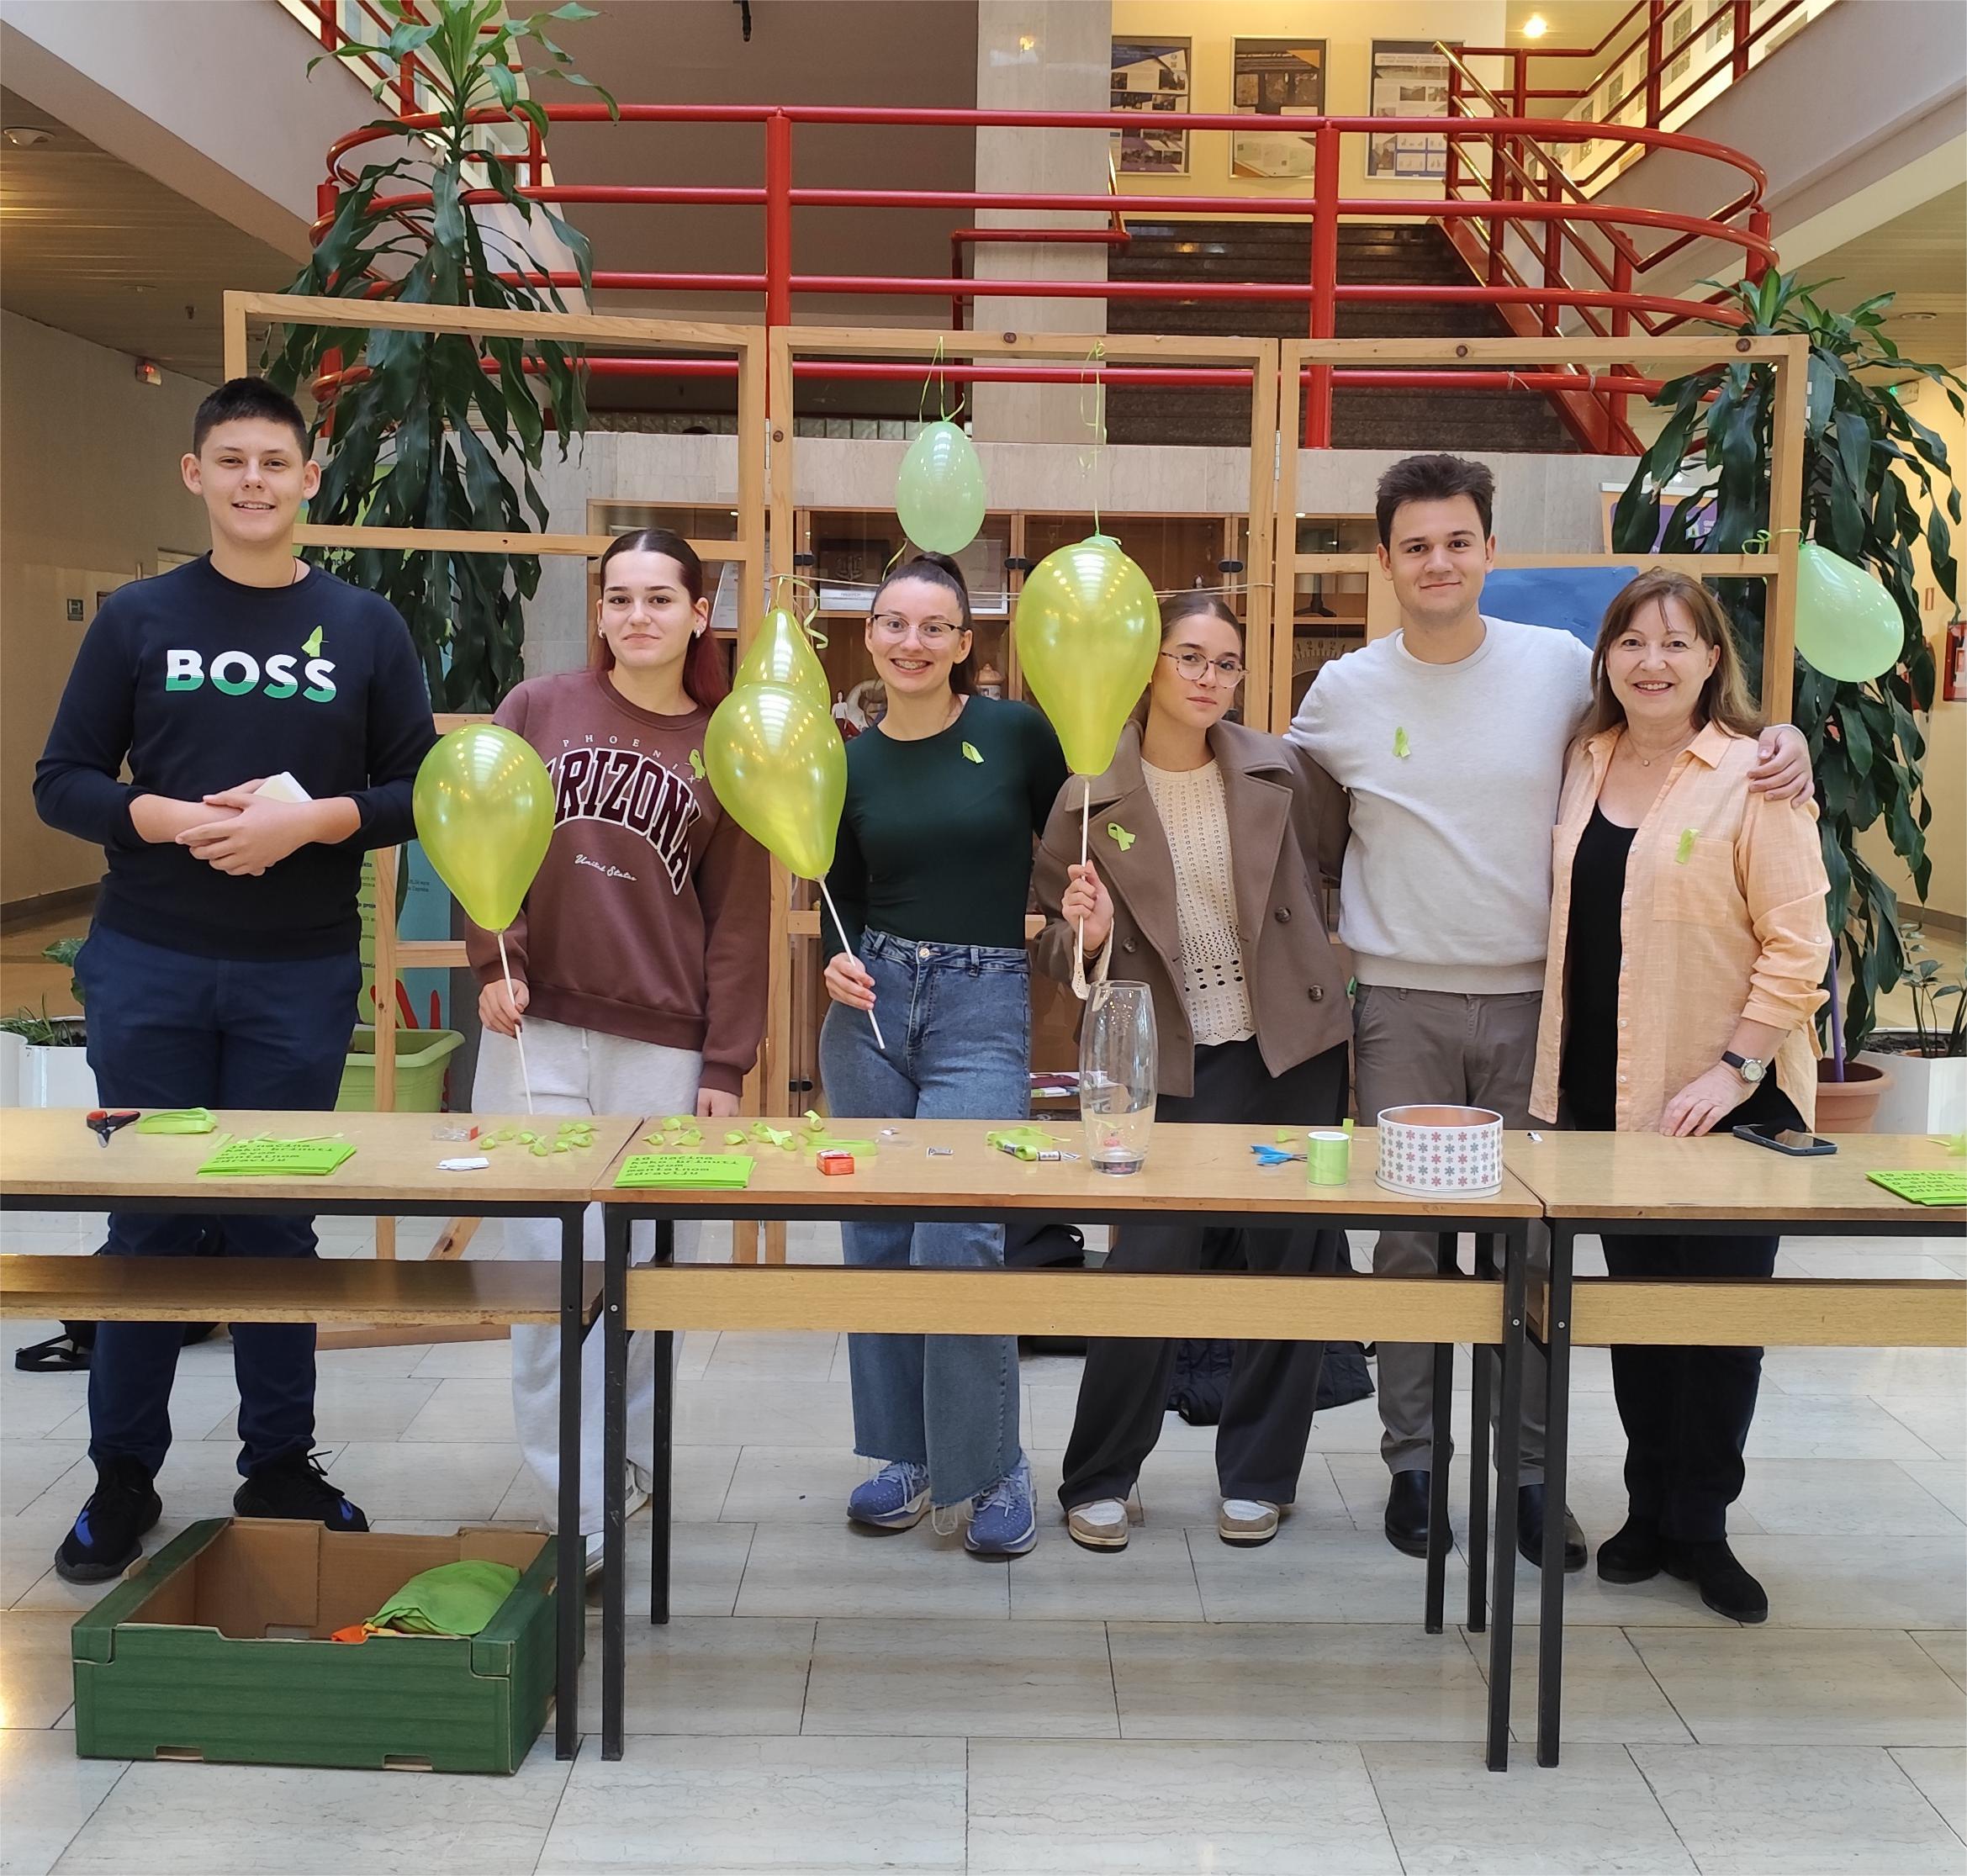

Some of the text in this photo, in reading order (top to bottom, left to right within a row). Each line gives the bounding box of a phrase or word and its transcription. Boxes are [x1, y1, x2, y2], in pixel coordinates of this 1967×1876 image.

[166, 649, 337, 703] BOSS
[562, 734, 696, 784] PHOENIX
[574, 853, 637, 881] United States
